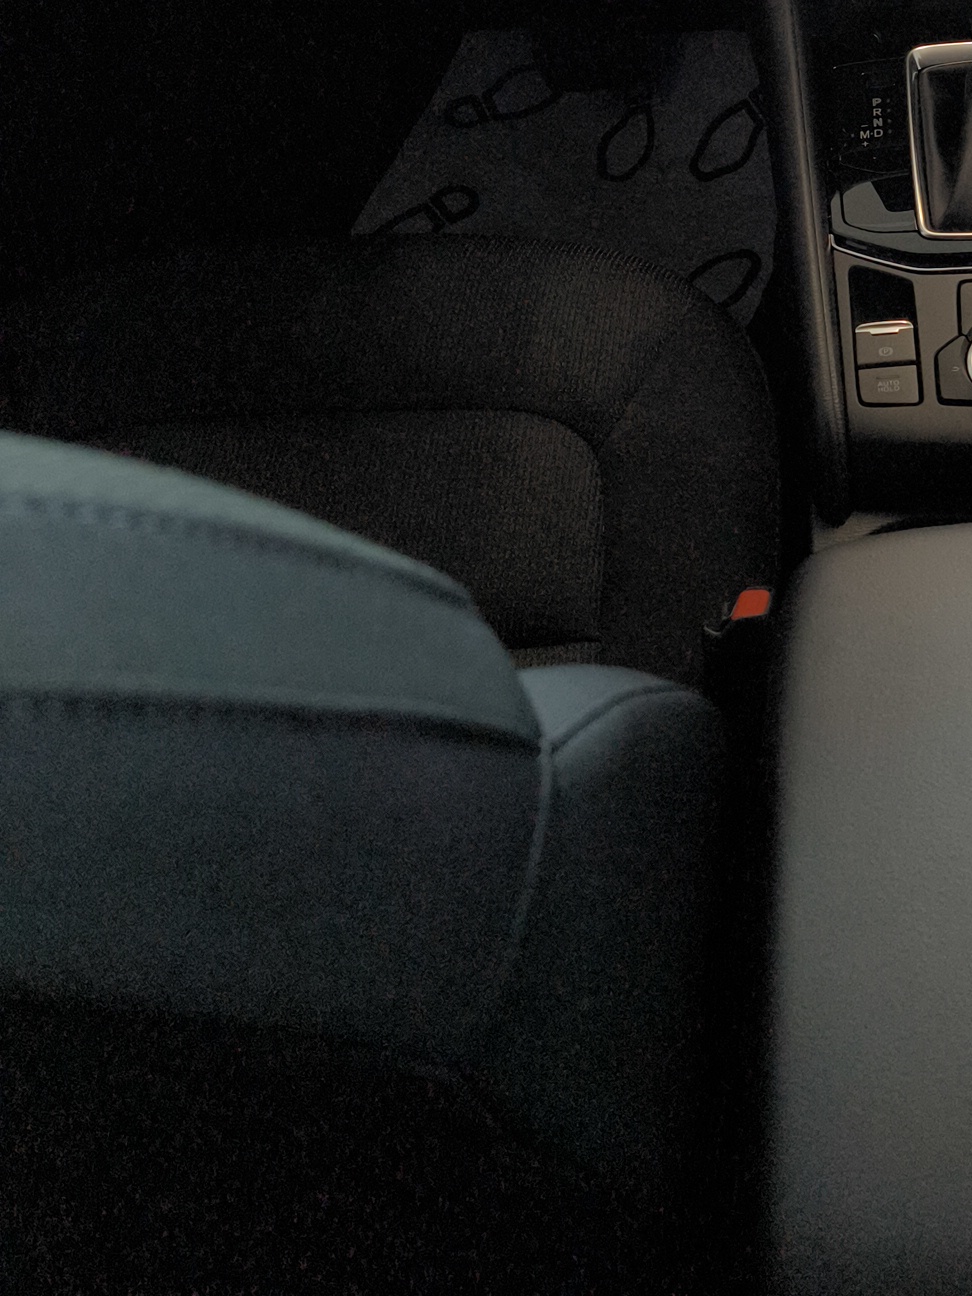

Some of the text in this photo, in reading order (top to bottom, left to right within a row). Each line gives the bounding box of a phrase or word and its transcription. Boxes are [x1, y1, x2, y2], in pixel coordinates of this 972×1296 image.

[872, 98, 882, 107] P
[872, 108, 882, 116] R
[873, 118, 883, 127] N
[859, 128, 884, 139] M D
